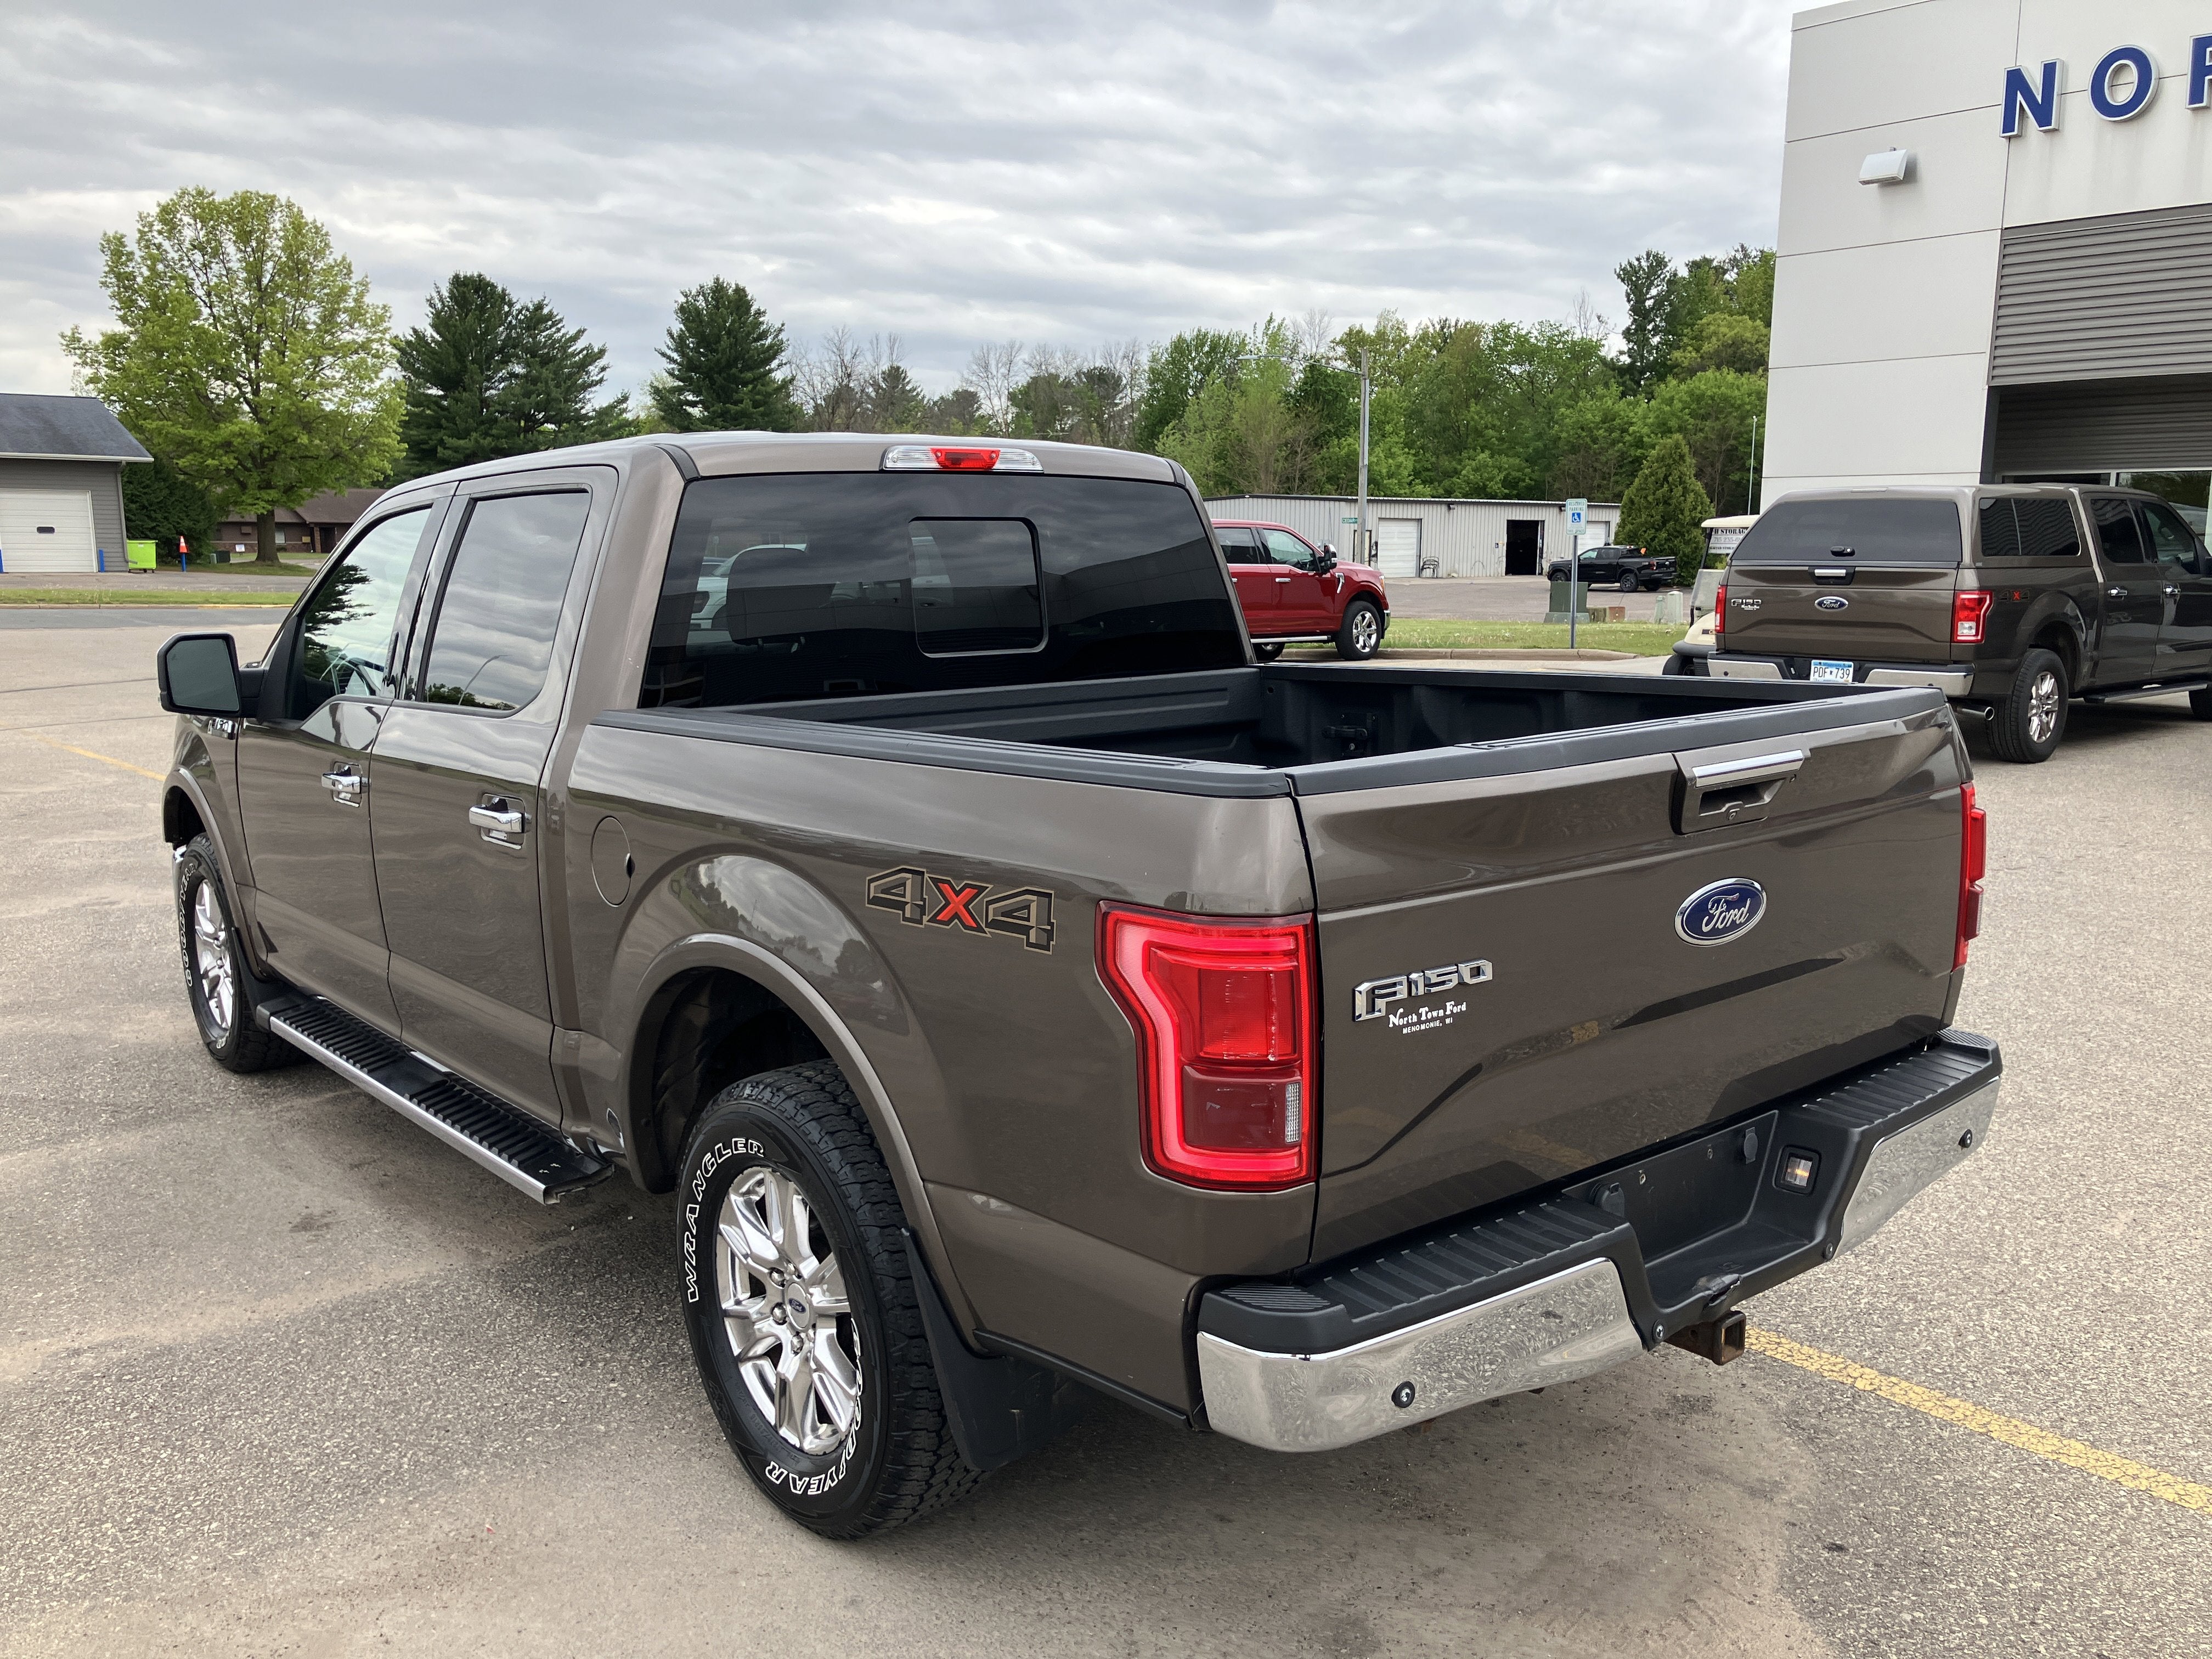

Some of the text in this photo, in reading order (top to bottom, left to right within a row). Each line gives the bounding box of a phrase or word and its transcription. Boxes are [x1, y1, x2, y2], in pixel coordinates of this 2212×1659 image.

[1821, 599, 1839, 608] Ford
[1813, 667, 1850, 679] PDF 739
[865, 865, 1056, 955] 4X4
[1702, 893, 1751, 933] Ford
[1352, 958, 1493, 1022] F150
[1389, 1001, 1467, 1028] North Town Ford
[1402, 1017, 1453, 1034] MENOMONIE, WI
[684, 1137, 765, 1303] WRANGLER
